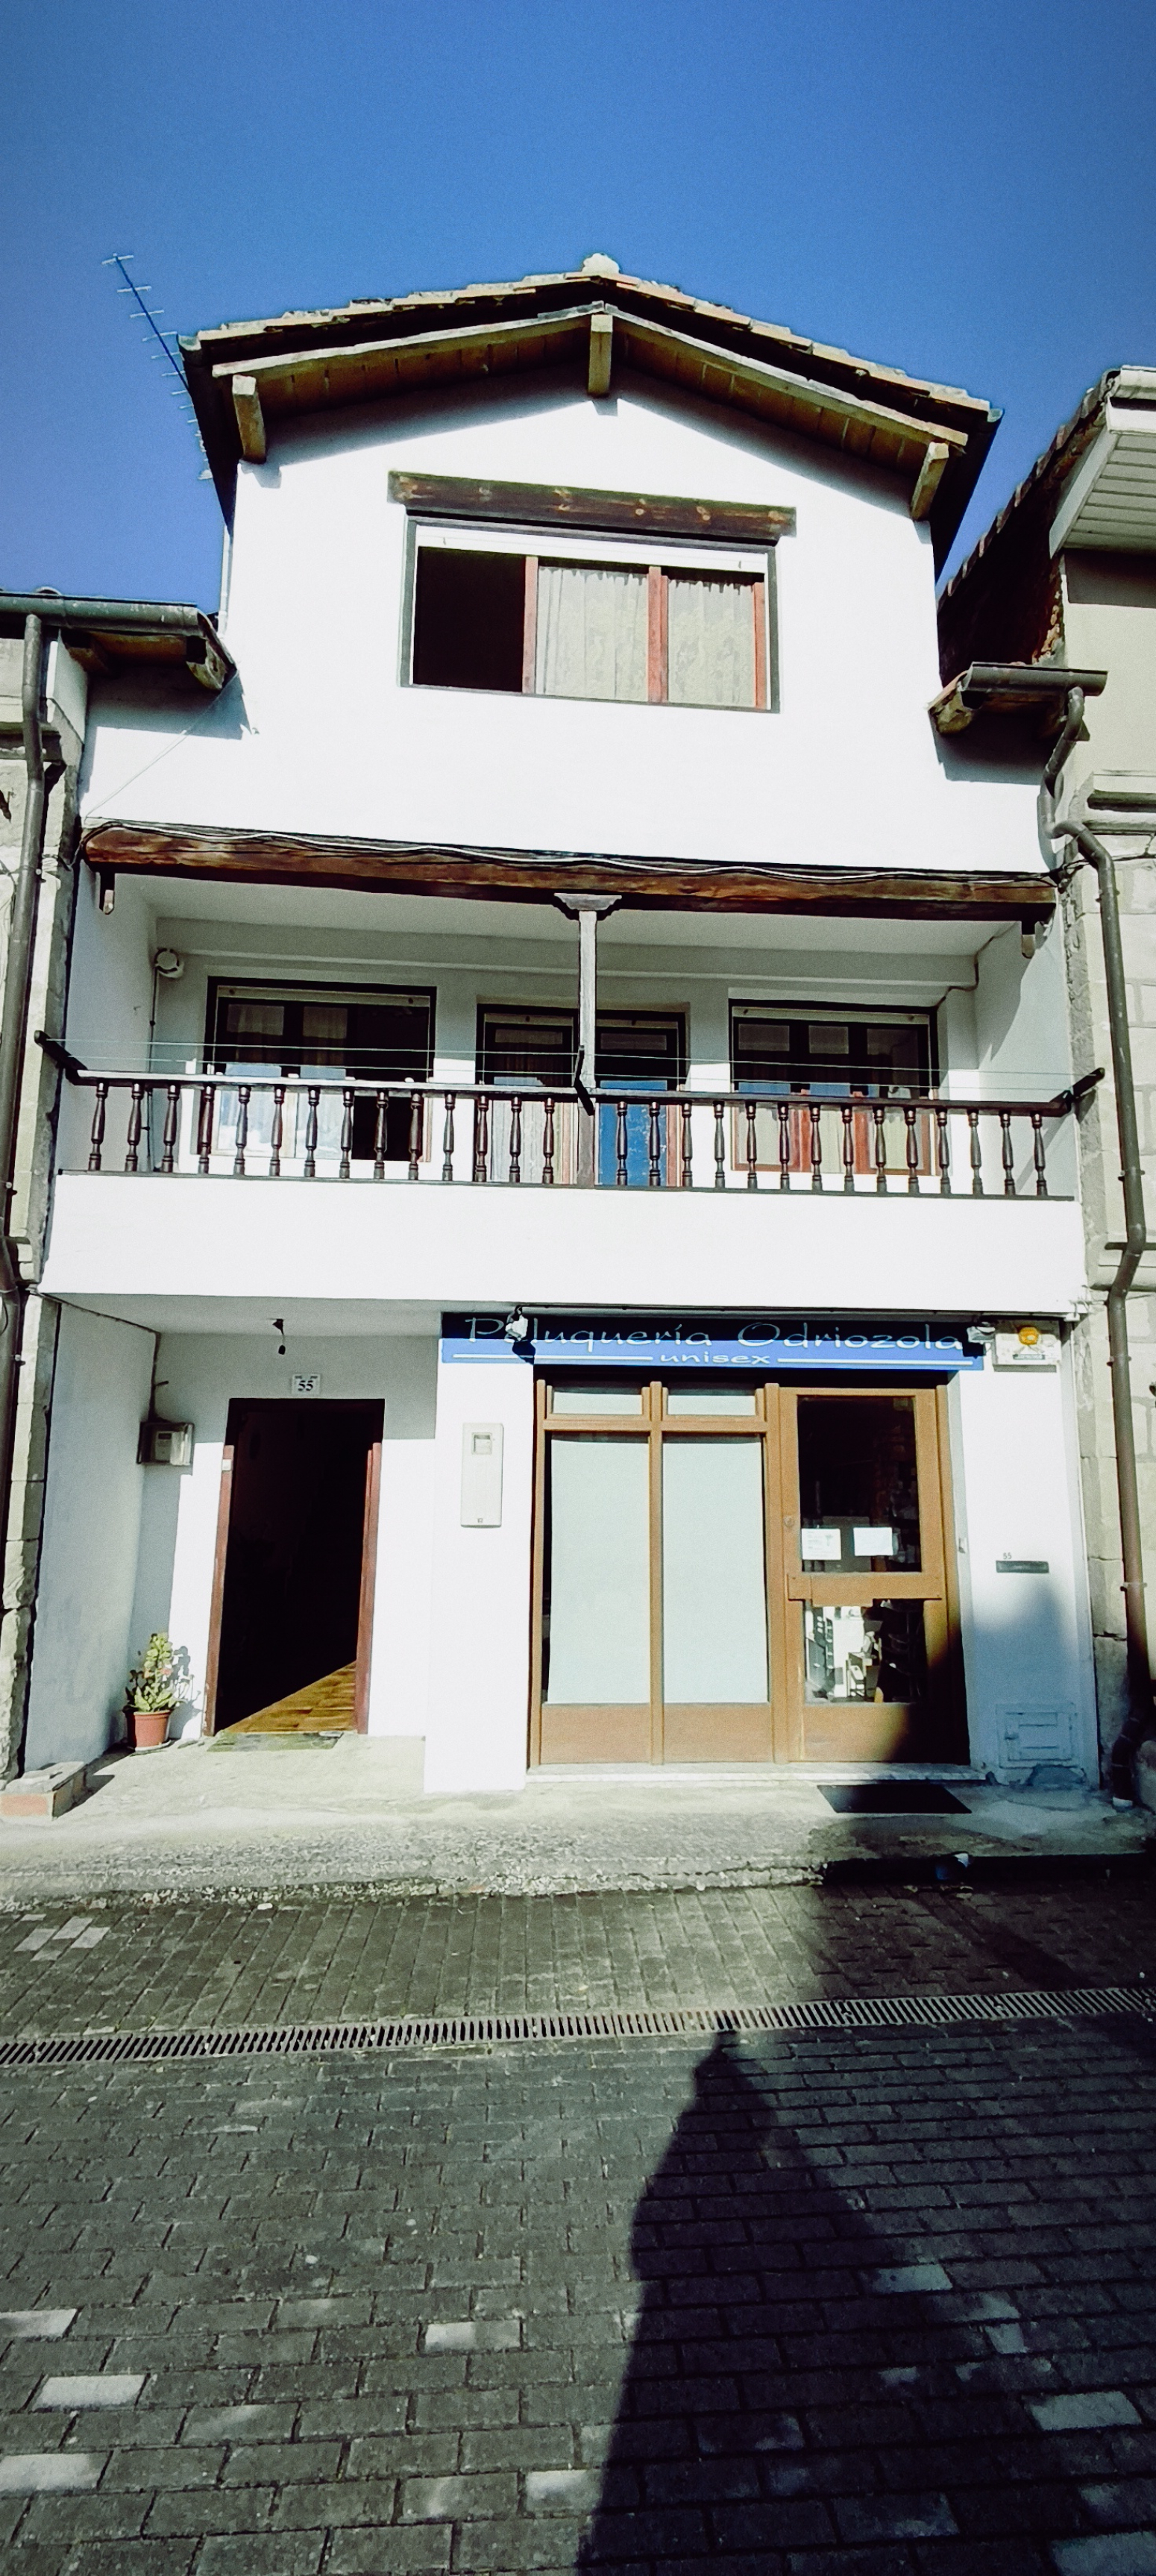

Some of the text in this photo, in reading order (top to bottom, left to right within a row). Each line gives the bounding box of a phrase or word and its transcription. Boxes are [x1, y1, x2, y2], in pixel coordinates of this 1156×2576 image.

[738, 1321, 964, 1350] Odriozola
[660, 1350, 770, 1366] unisex
[298, 1379, 314, 1392] 55
[1002, 1552, 1013, 1560] 55
